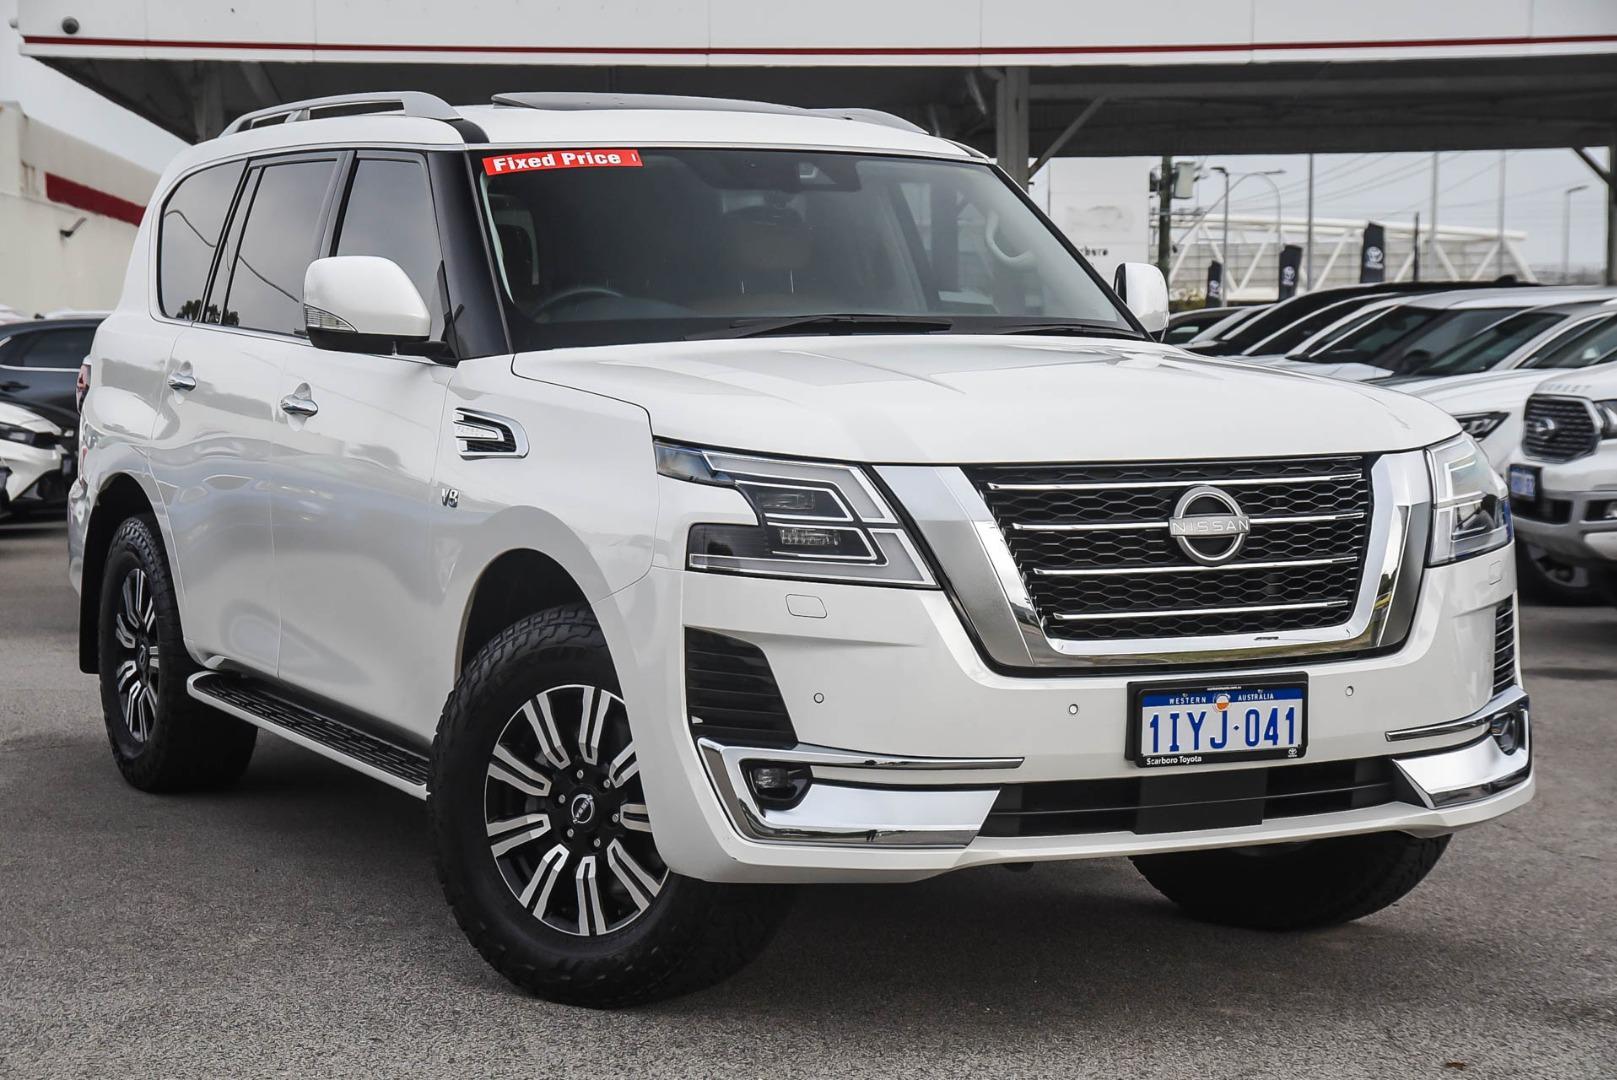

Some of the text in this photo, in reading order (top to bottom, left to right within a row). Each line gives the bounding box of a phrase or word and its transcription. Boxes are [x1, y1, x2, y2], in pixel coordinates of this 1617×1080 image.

[493, 152, 621, 172] Fixed Price
[441, 488, 459, 508] V8
[1172, 519, 1249, 533] NISSAN
[1169, 693, 1275, 705] WESTERN AUSTRALIA
[1146, 755, 1202, 765] Scarboro Toyota
